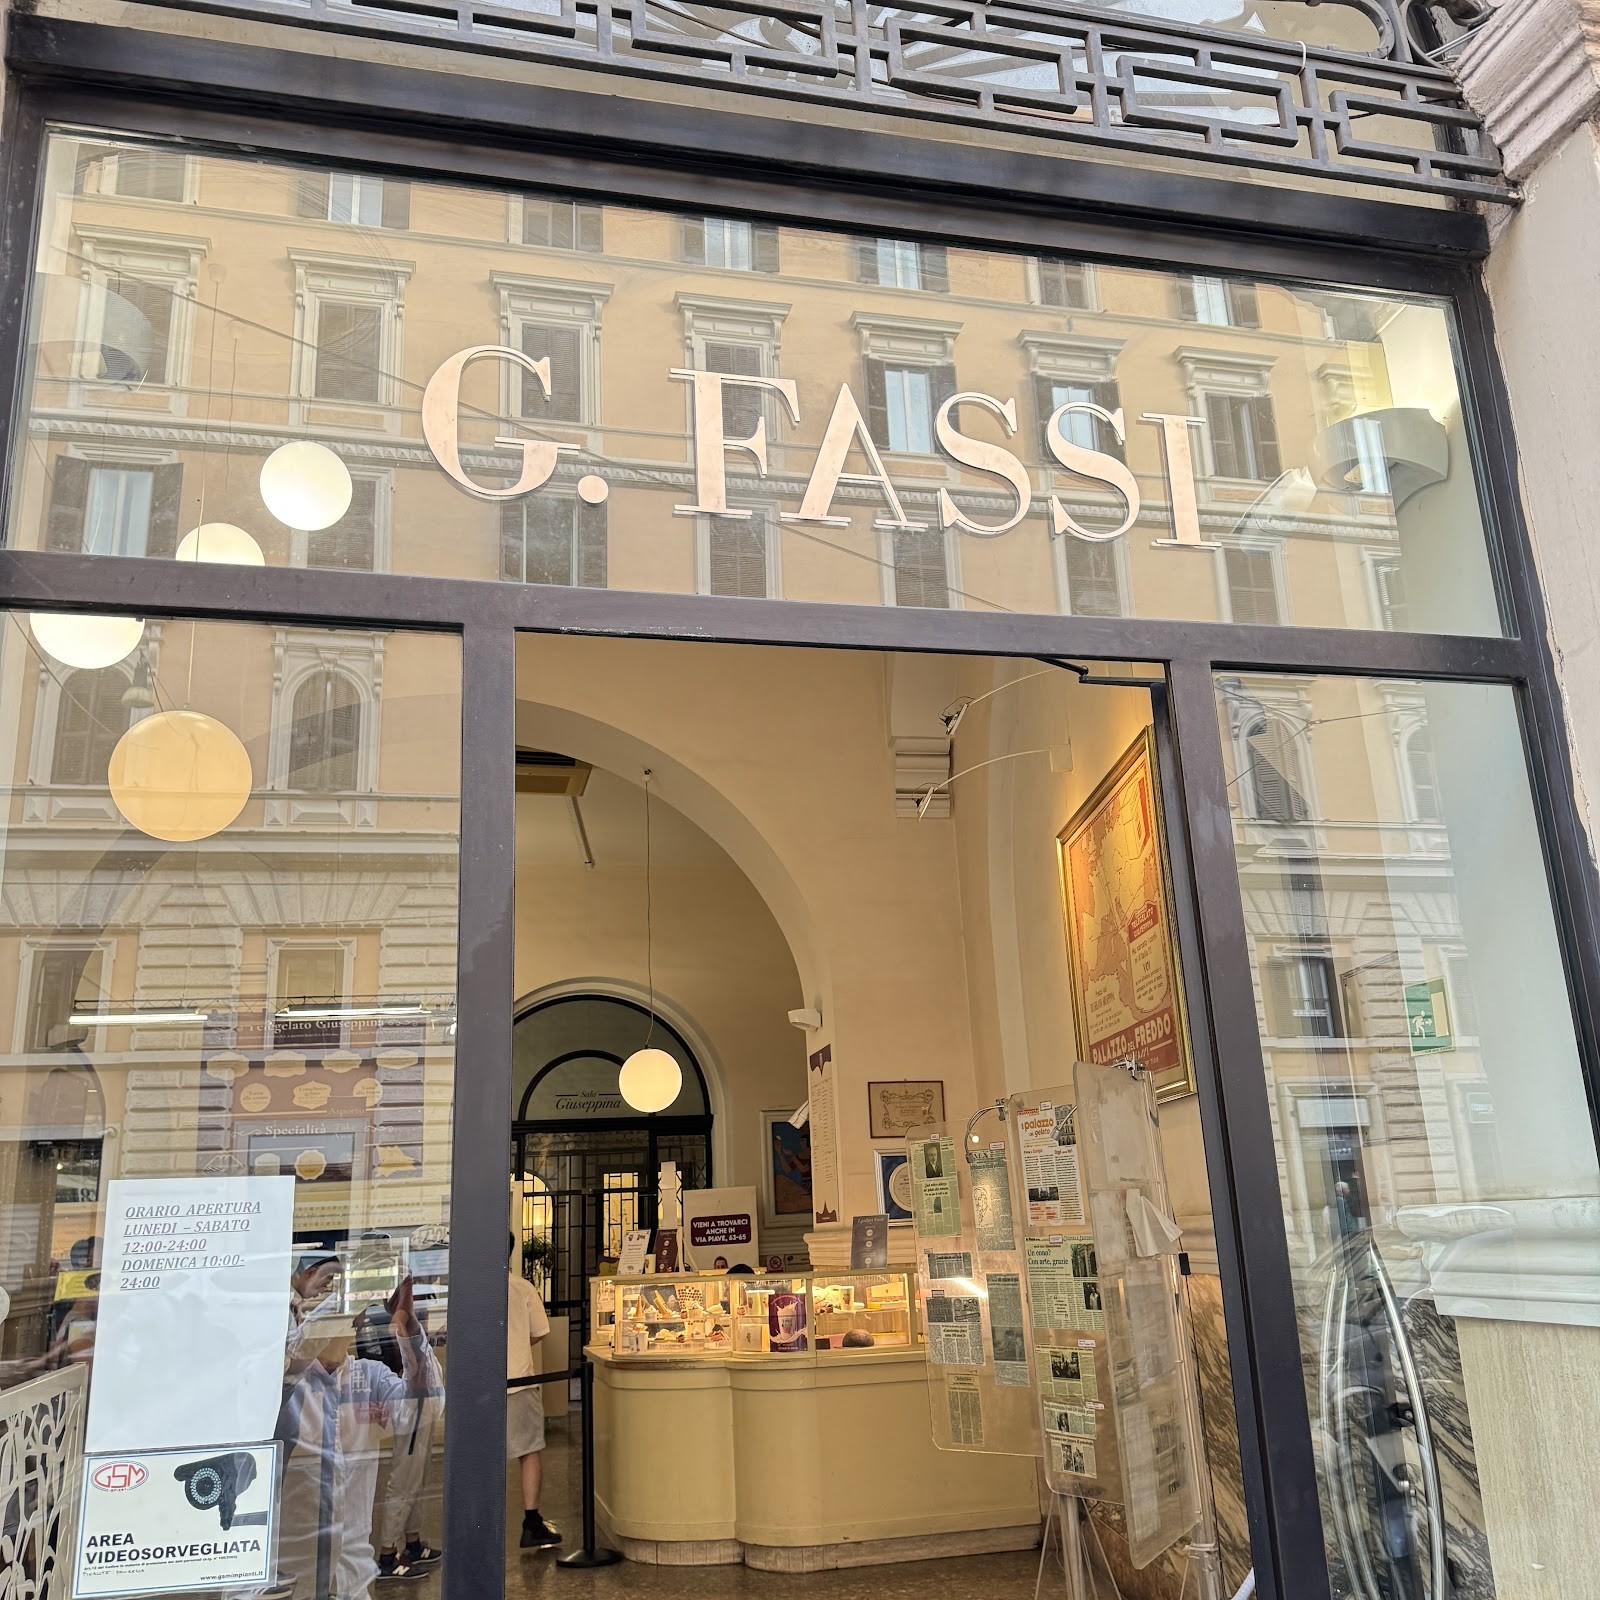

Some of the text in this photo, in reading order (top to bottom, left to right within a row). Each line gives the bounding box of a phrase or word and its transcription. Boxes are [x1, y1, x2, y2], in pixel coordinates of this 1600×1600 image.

[422, 345, 1222, 549] G. FASSI
[1092, 1034, 1127, 1066] PALAZZO
[1135, 1012, 1171, 1049] FREDDO
[555, 1098, 621, 1113] Giuseppina
[265, 1124, 327, 1138] Specialità
[1024, 1118, 1054, 1131] palazzo
[125, 1201, 262, 1219] ORARIO APERTURA
[123, 1222, 178, 1237] LUNEDI
[193, 1219, 250, 1234] SABATO
[706, 1227, 727, 1235] ANCHE
[122, 1238, 207, 1255] 12:00-24:00
[1027, 1249, 1036, 1257] Un
[121, 1254, 245, 1273] DOMENICA 10:00-
[1052, 1257, 1069, 1266] grazie
[120, 1276, 160, 1291] 24:00
[94, 1464, 146, 1488] GSM
[86, 1533, 134, 1548] AREA
[86, 1539, 261, 1564] VIDEOSORVEGLIATA
